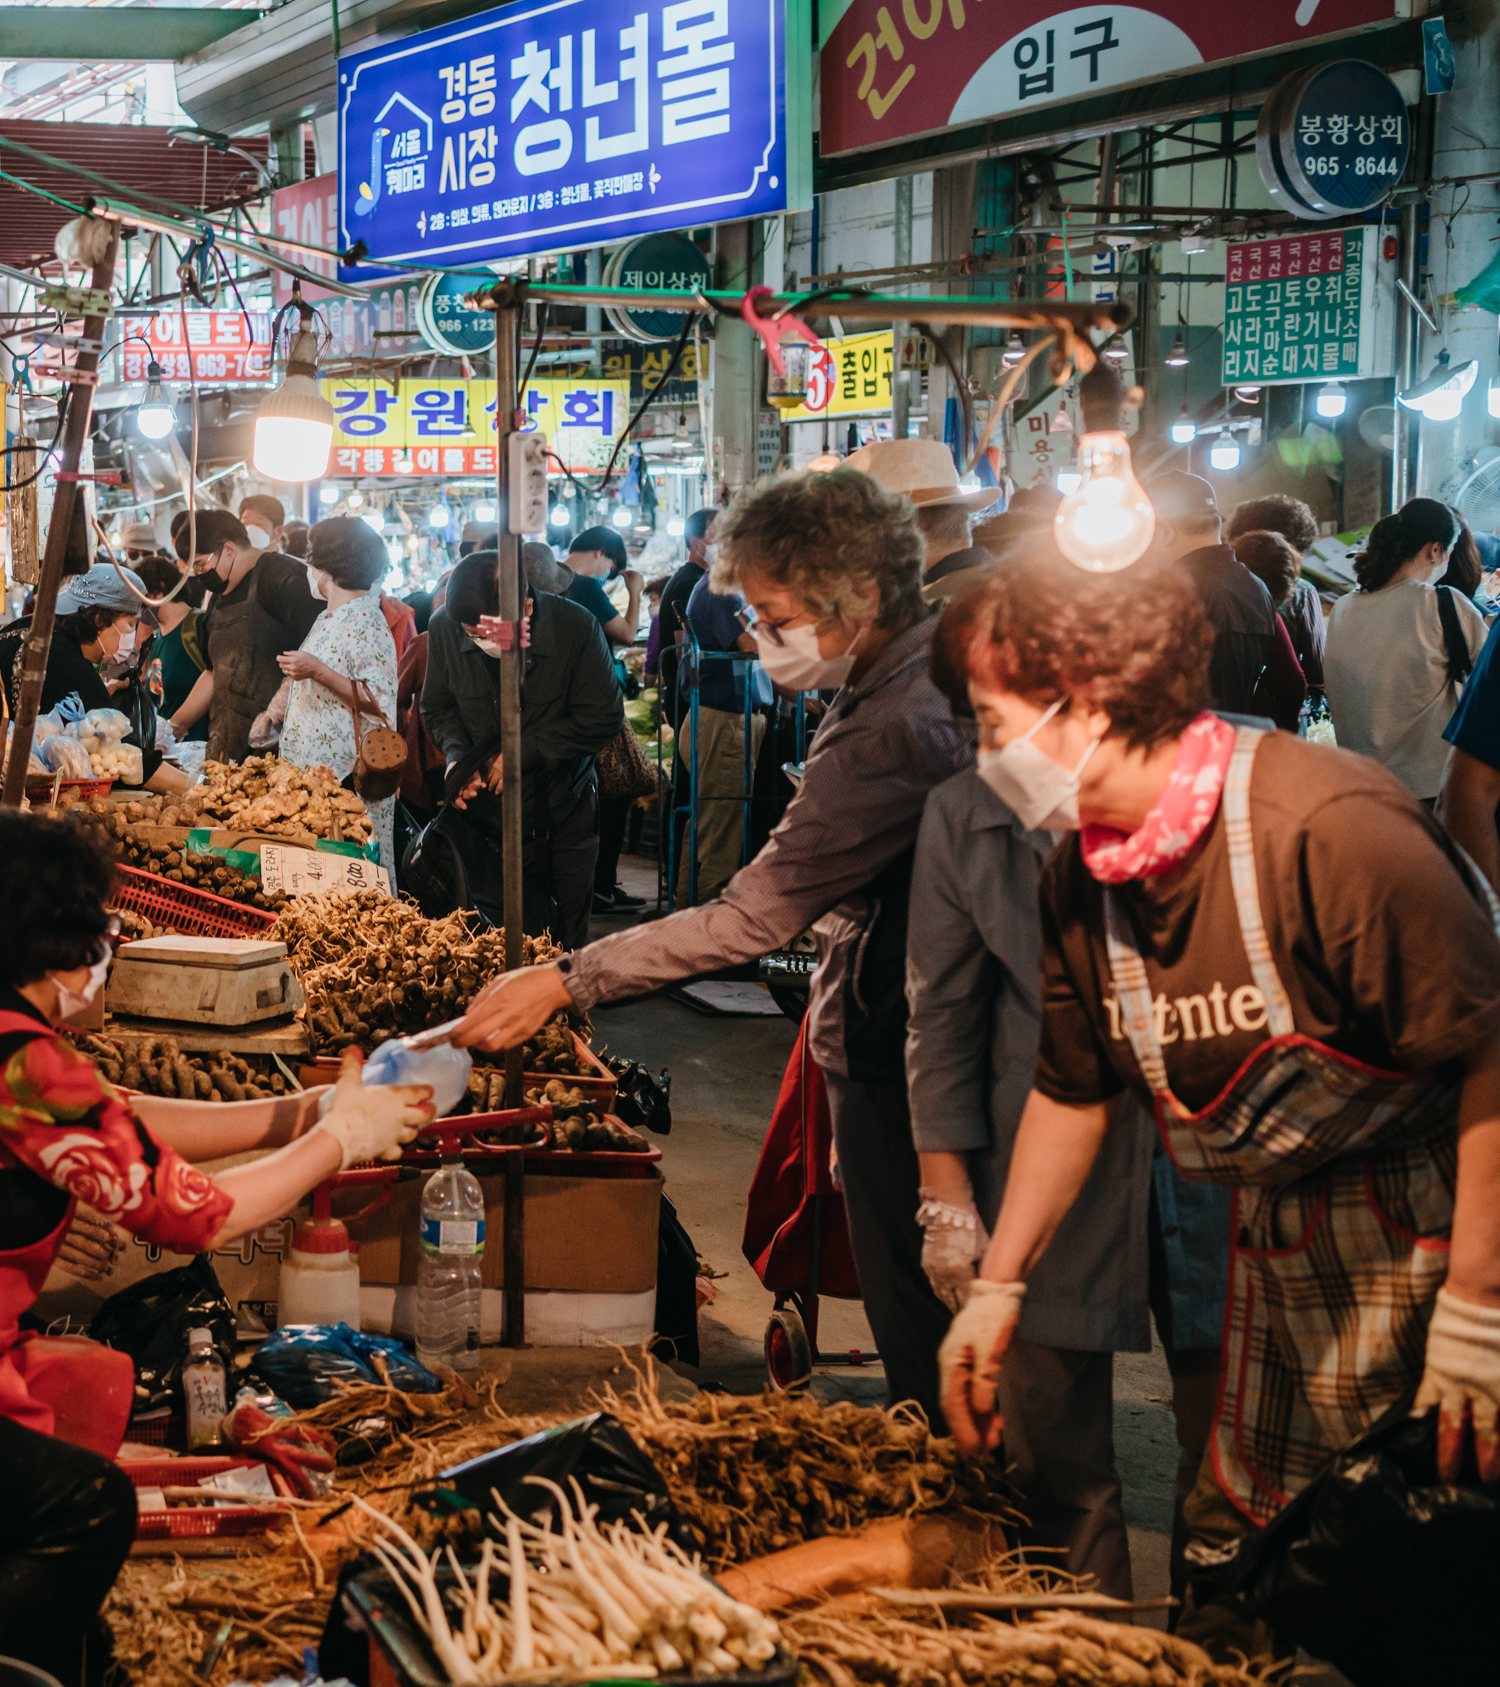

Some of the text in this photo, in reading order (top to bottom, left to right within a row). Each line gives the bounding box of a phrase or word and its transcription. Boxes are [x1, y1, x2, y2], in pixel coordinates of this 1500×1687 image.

[438, 53, 498, 125] 경동
[510, 0, 735, 177] 청년몰
[1013, 16, 1120, 100] 입구
[390, 128, 421, 159] 서울
[439, 125, 498, 194] 시장
[1298, 114, 1403, 146] 봉황상회
[1225, 250, 1243, 378] 국산 고사리
[1243, 247, 1262, 376] 국산 도라지
[1262, 245, 1281, 376] 국산 고구마순
[1282, 242, 1302, 374] 국산 토란대
[1302, 240, 1322, 372] 국산 우거지
[1322, 237, 1342, 371] 국산 취나물
[842, 347, 893, 399] 출입구
[336, 448, 385, 473] 각종
[472, 448, 499, 473] 도
